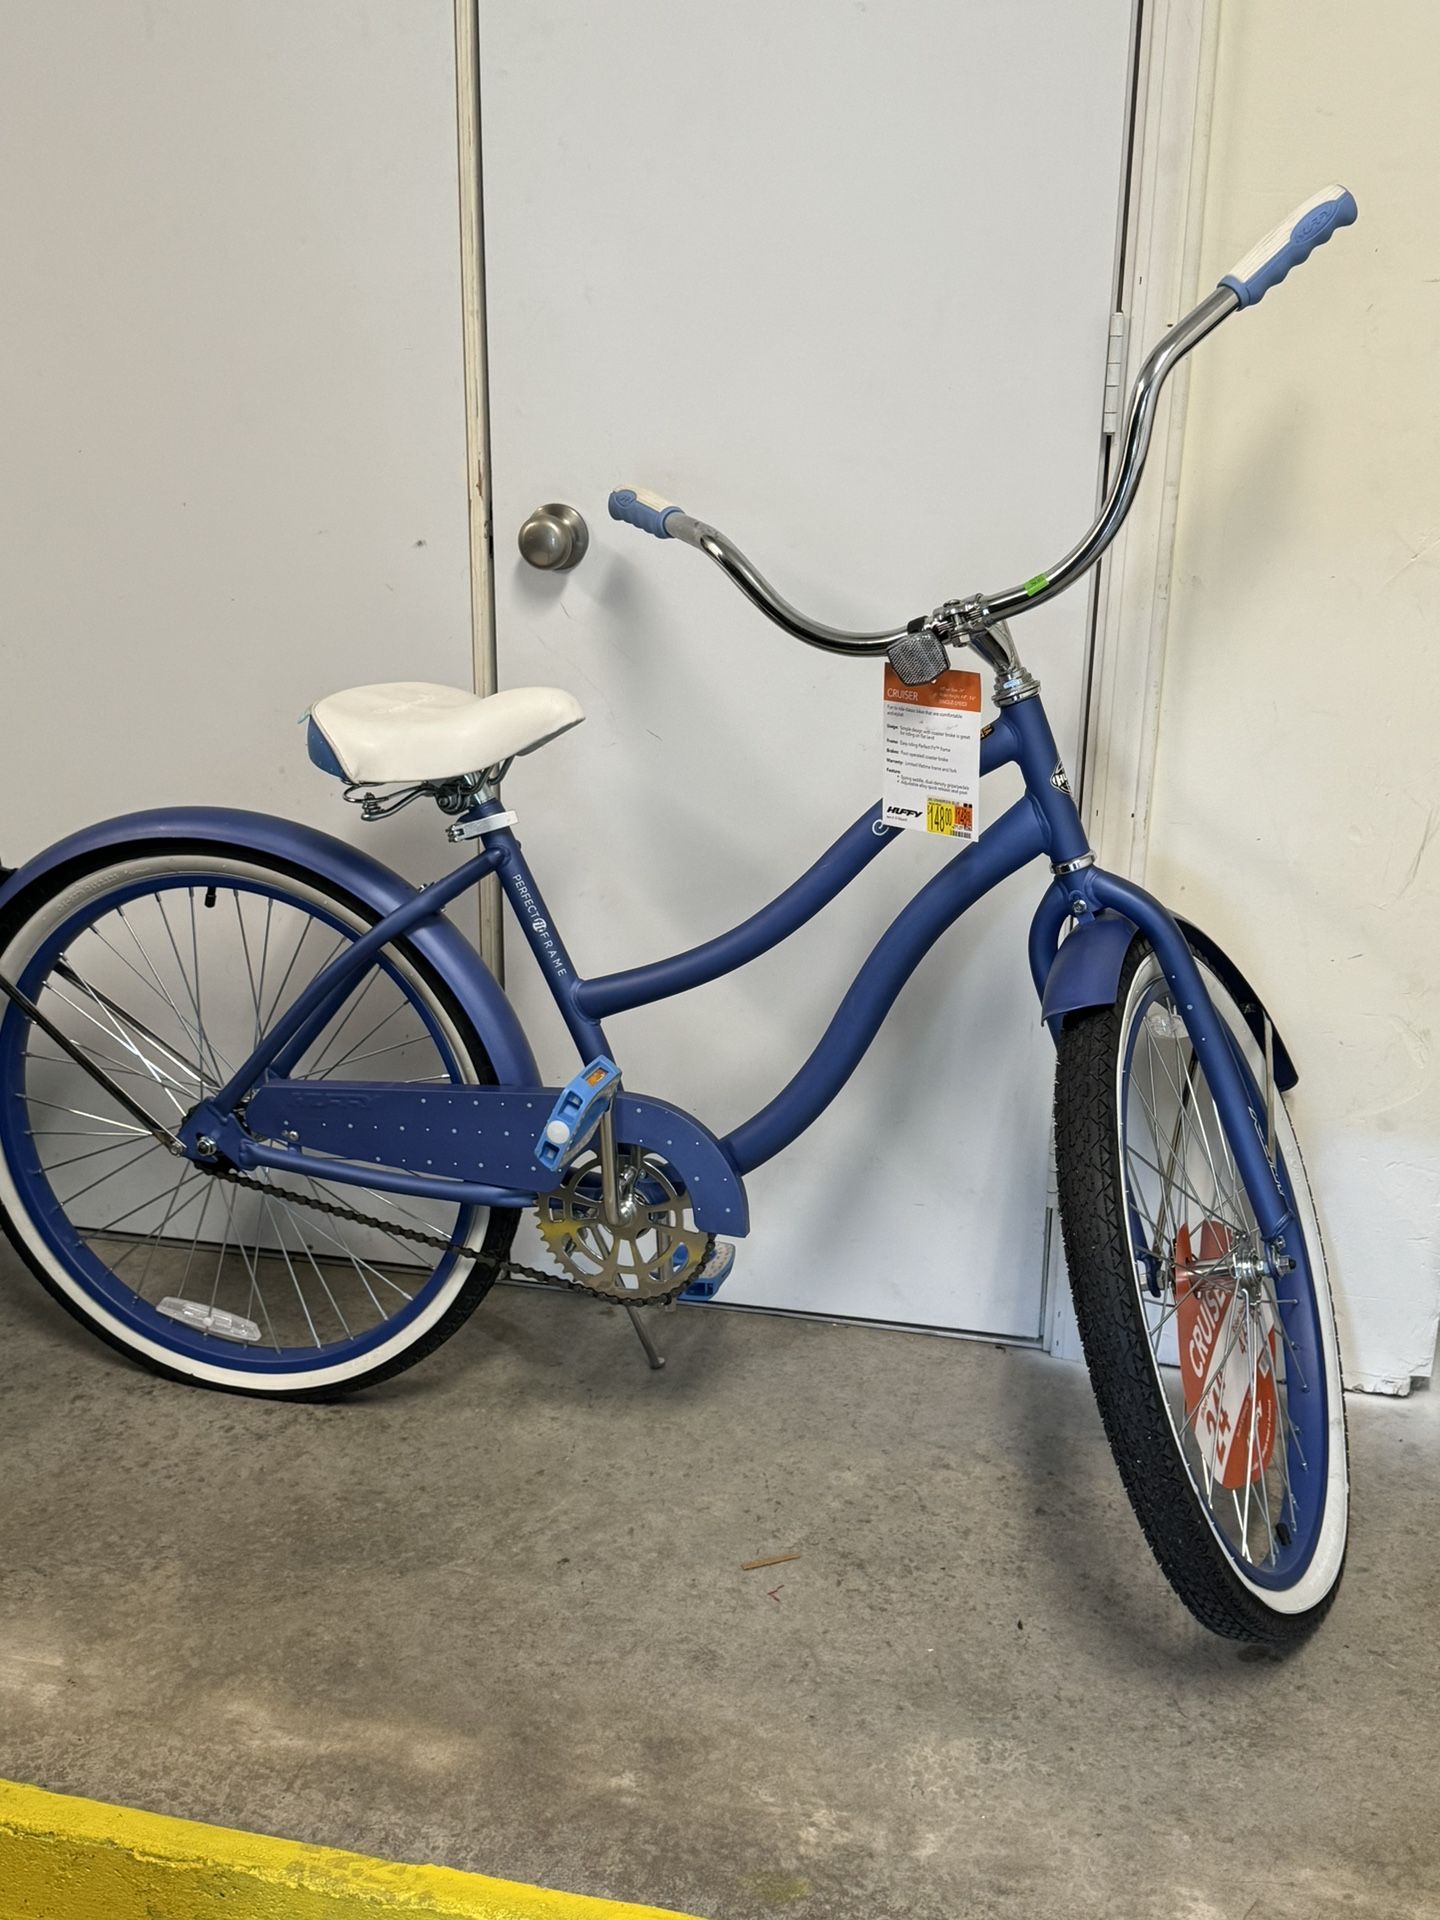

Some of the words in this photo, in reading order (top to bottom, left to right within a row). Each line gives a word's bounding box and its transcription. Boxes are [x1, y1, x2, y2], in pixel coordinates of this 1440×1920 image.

[887, 688, 918, 700] CRUISER
[887, 806, 923, 818] HUFFY
[512, 874, 540, 919] PERFECT
[541, 932, 568, 976] FRAME
[1189, 1287, 1229, 1378] CRUISE
